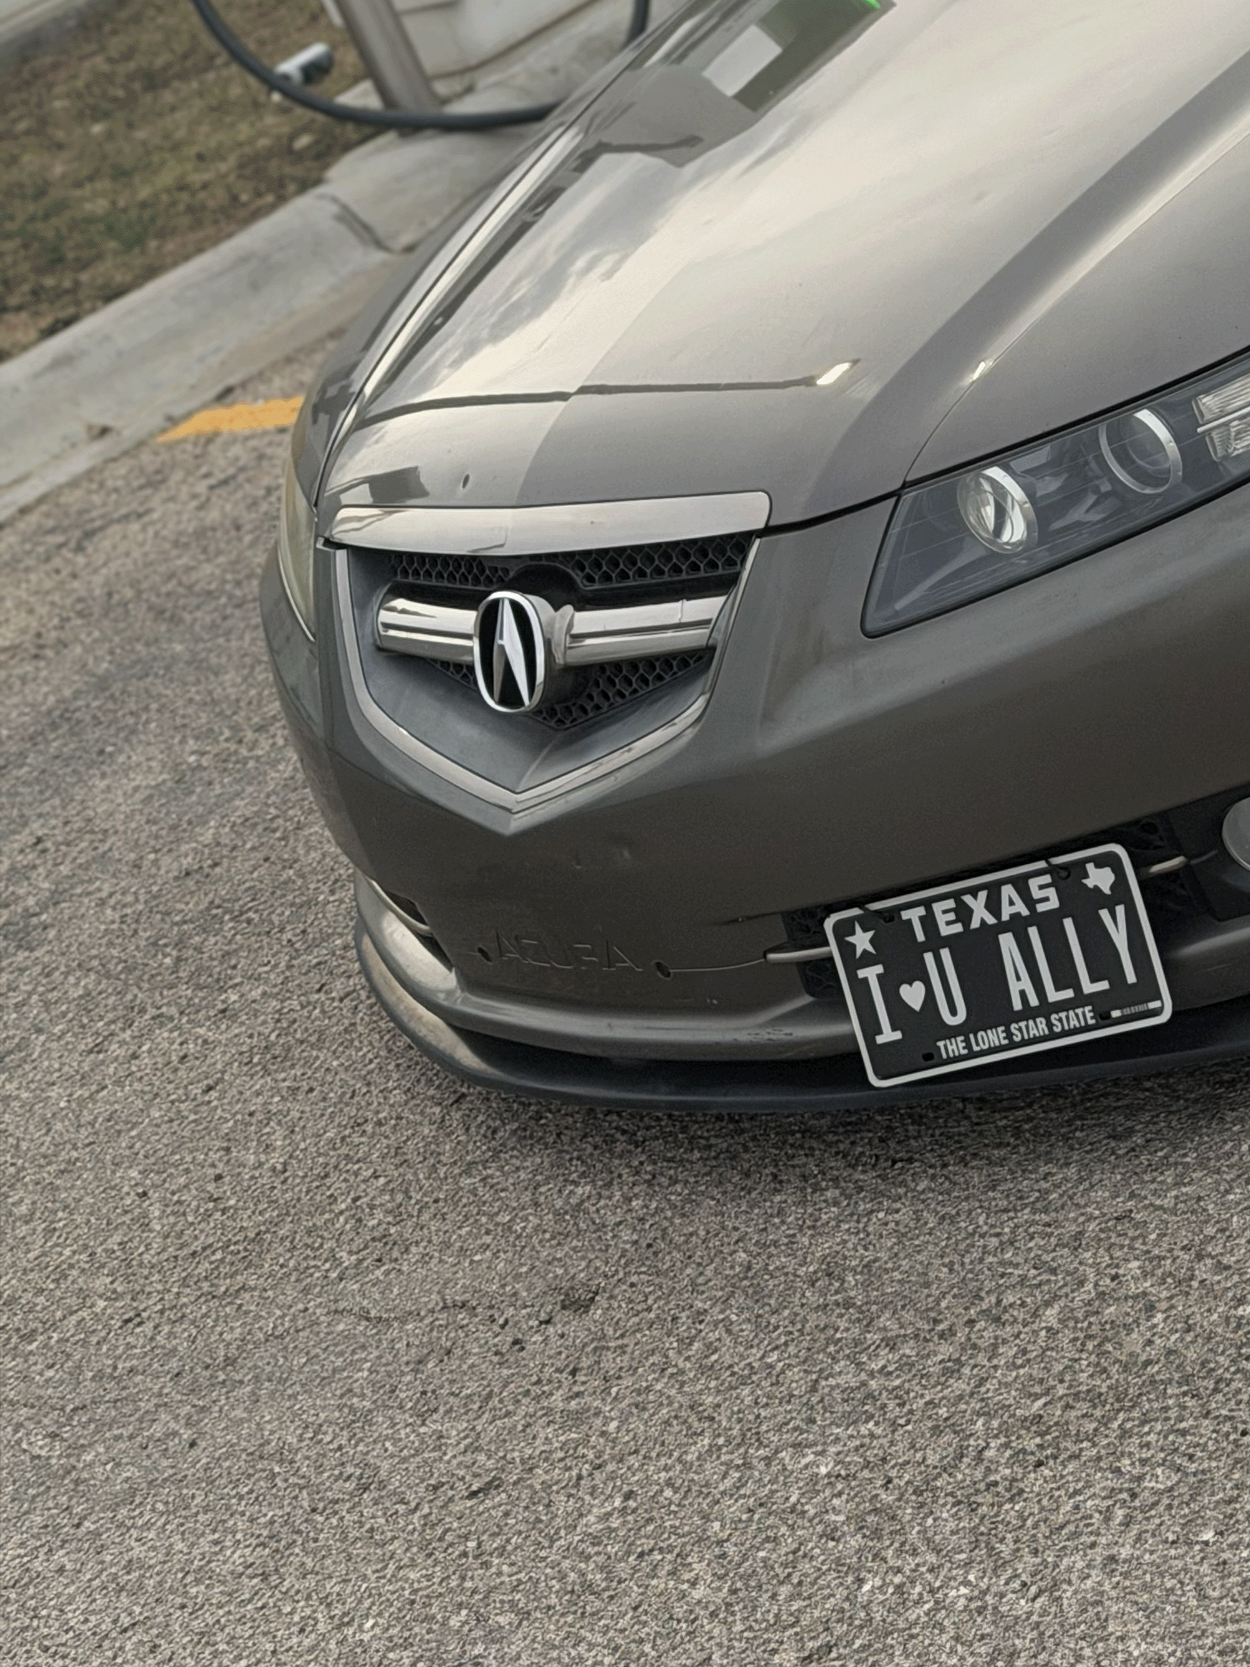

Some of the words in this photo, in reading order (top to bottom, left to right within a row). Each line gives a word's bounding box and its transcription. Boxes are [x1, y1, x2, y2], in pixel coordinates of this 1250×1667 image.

[900, 874, 1060, 943] TEXAS
[857, 964, 903, 1045] I
[923, 947, 968, 1027] U
[998, 904, 1138, 1012] ALLY
[936, 1035, 969, 1060] THE
[969, 1026, 1010, 1052] LONE
[1010, 1017, 1050, 1042] STAR
[1050, 1005, 1097, 1033] STATE
